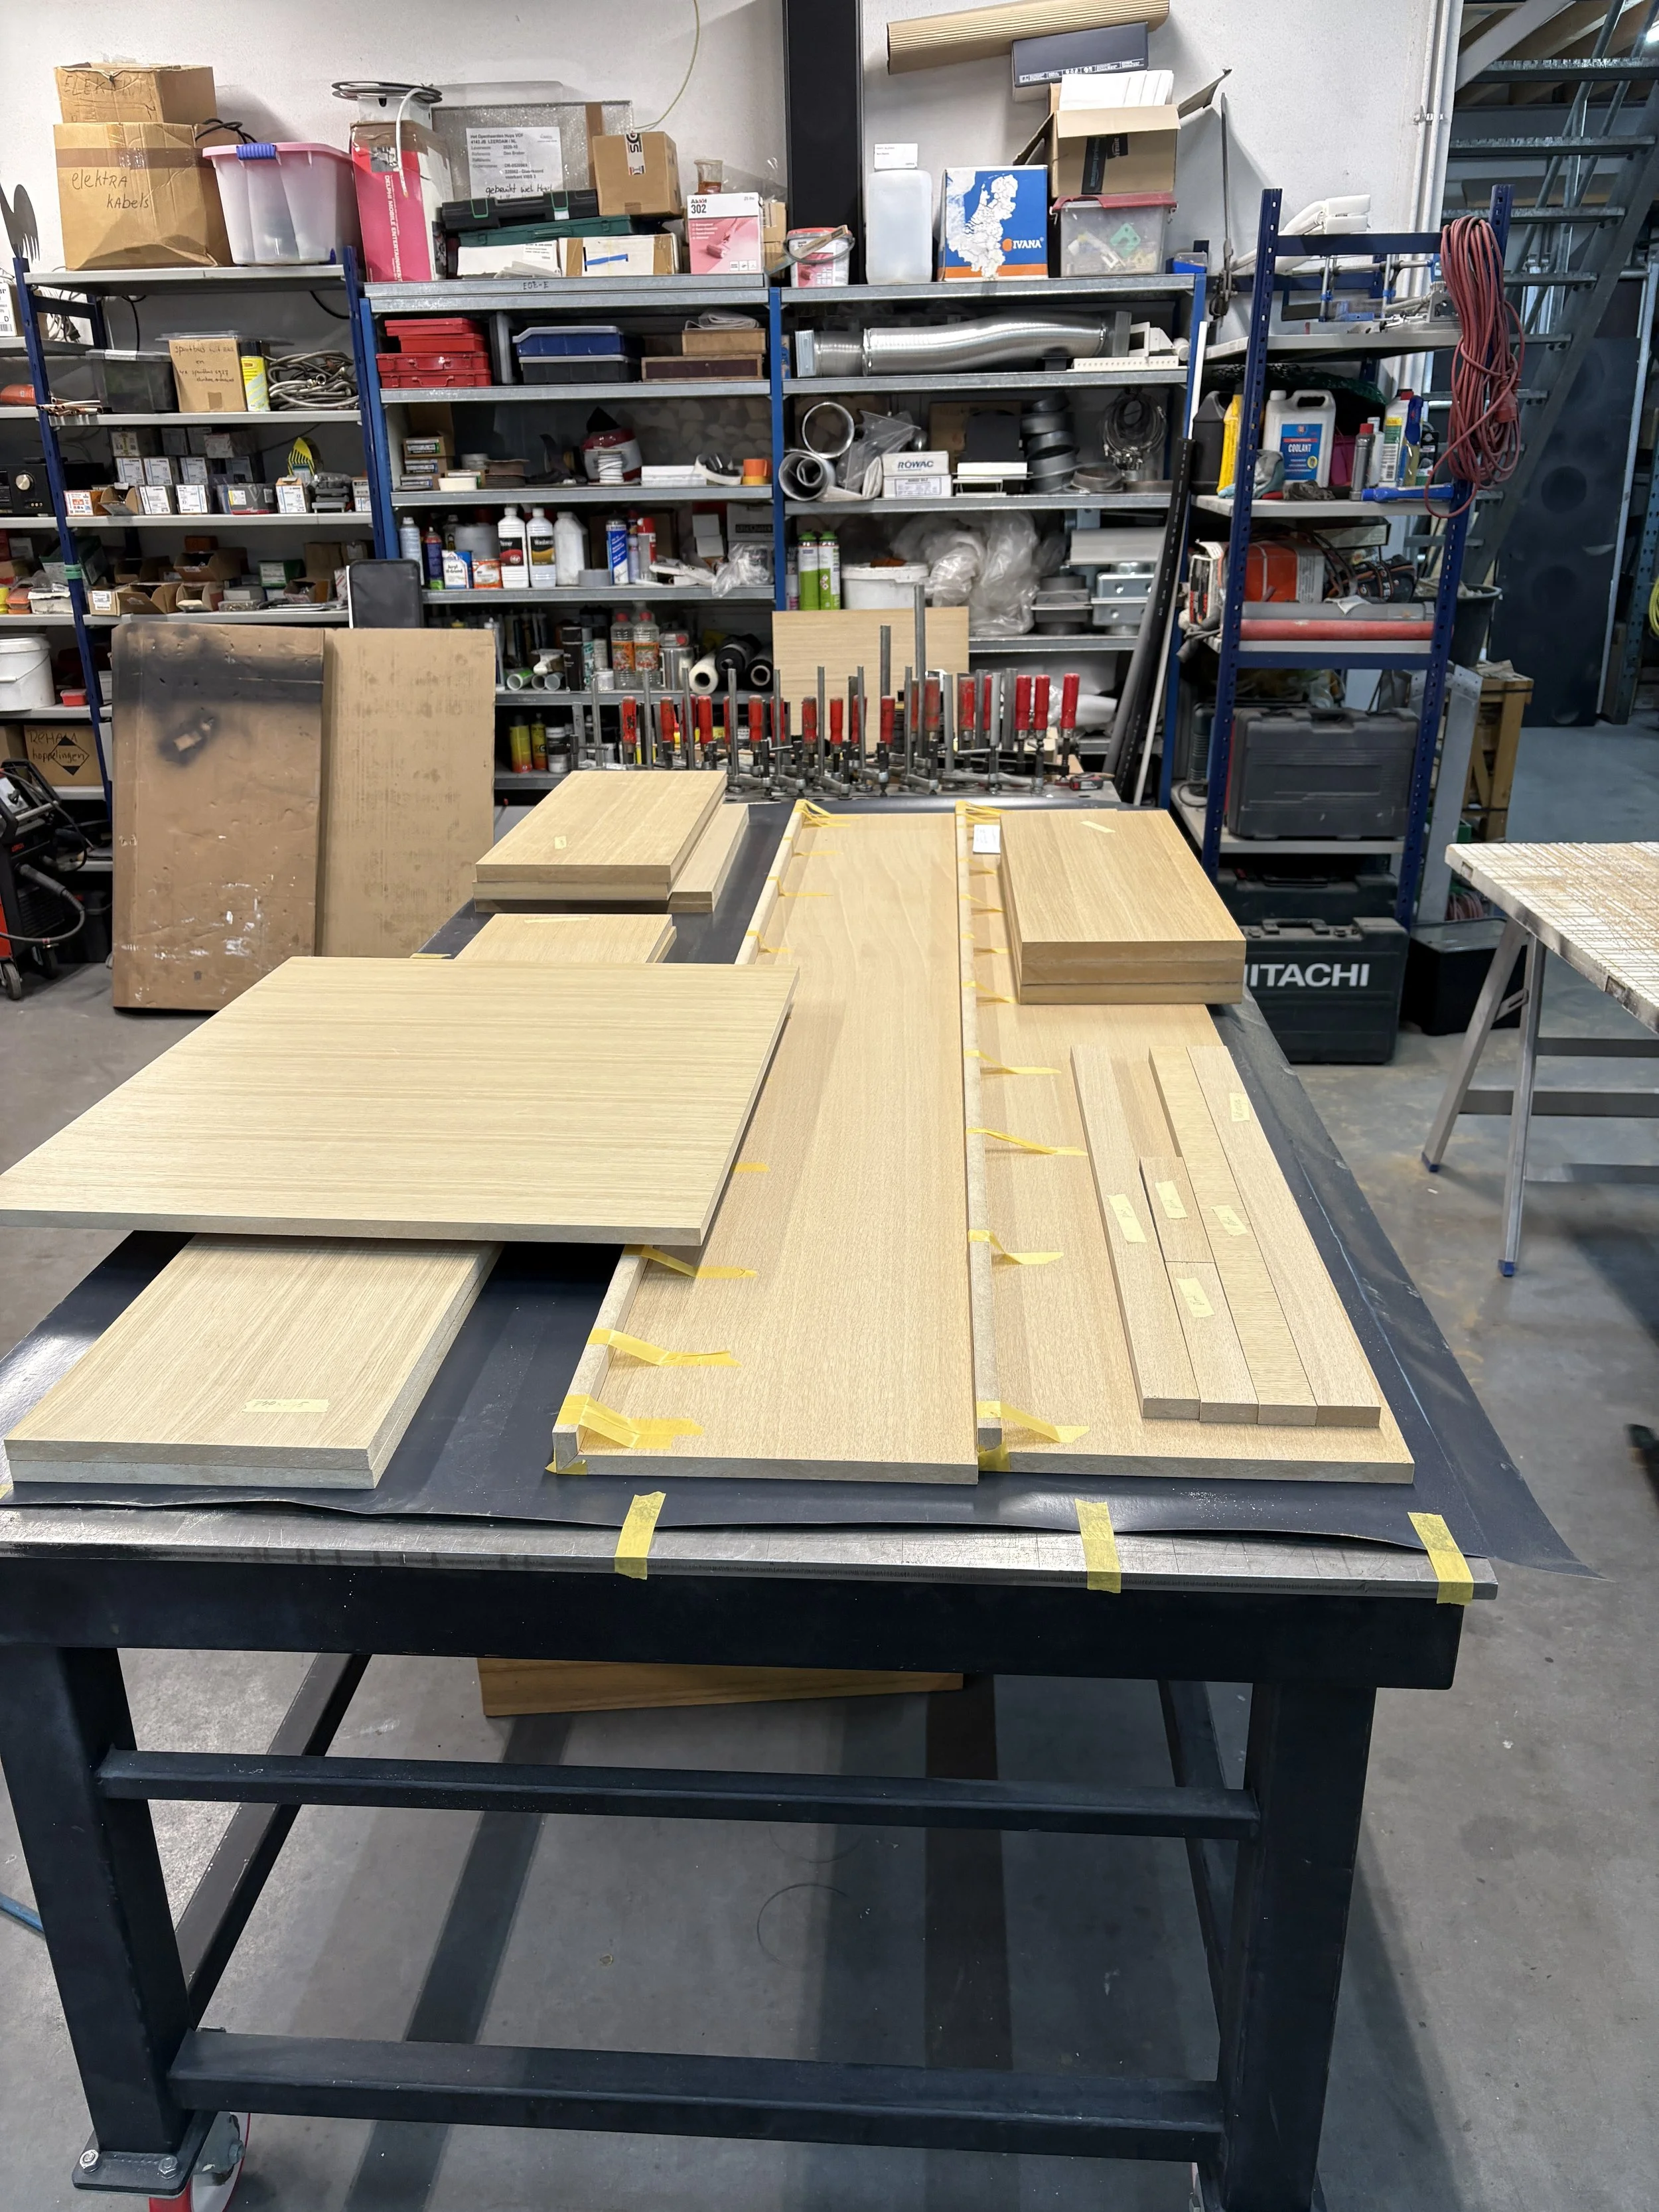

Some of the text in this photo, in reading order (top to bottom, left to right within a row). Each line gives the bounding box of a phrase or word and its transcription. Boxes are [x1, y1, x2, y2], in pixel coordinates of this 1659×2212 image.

[691, 204, 707, 214] 302
[384, 175, 403, 281] DELPHI MOBILE ENTERTAINMENT
[1013, 239, 1042, 249] IVANA
[1288, 443, 1311, 453] COOLANT
